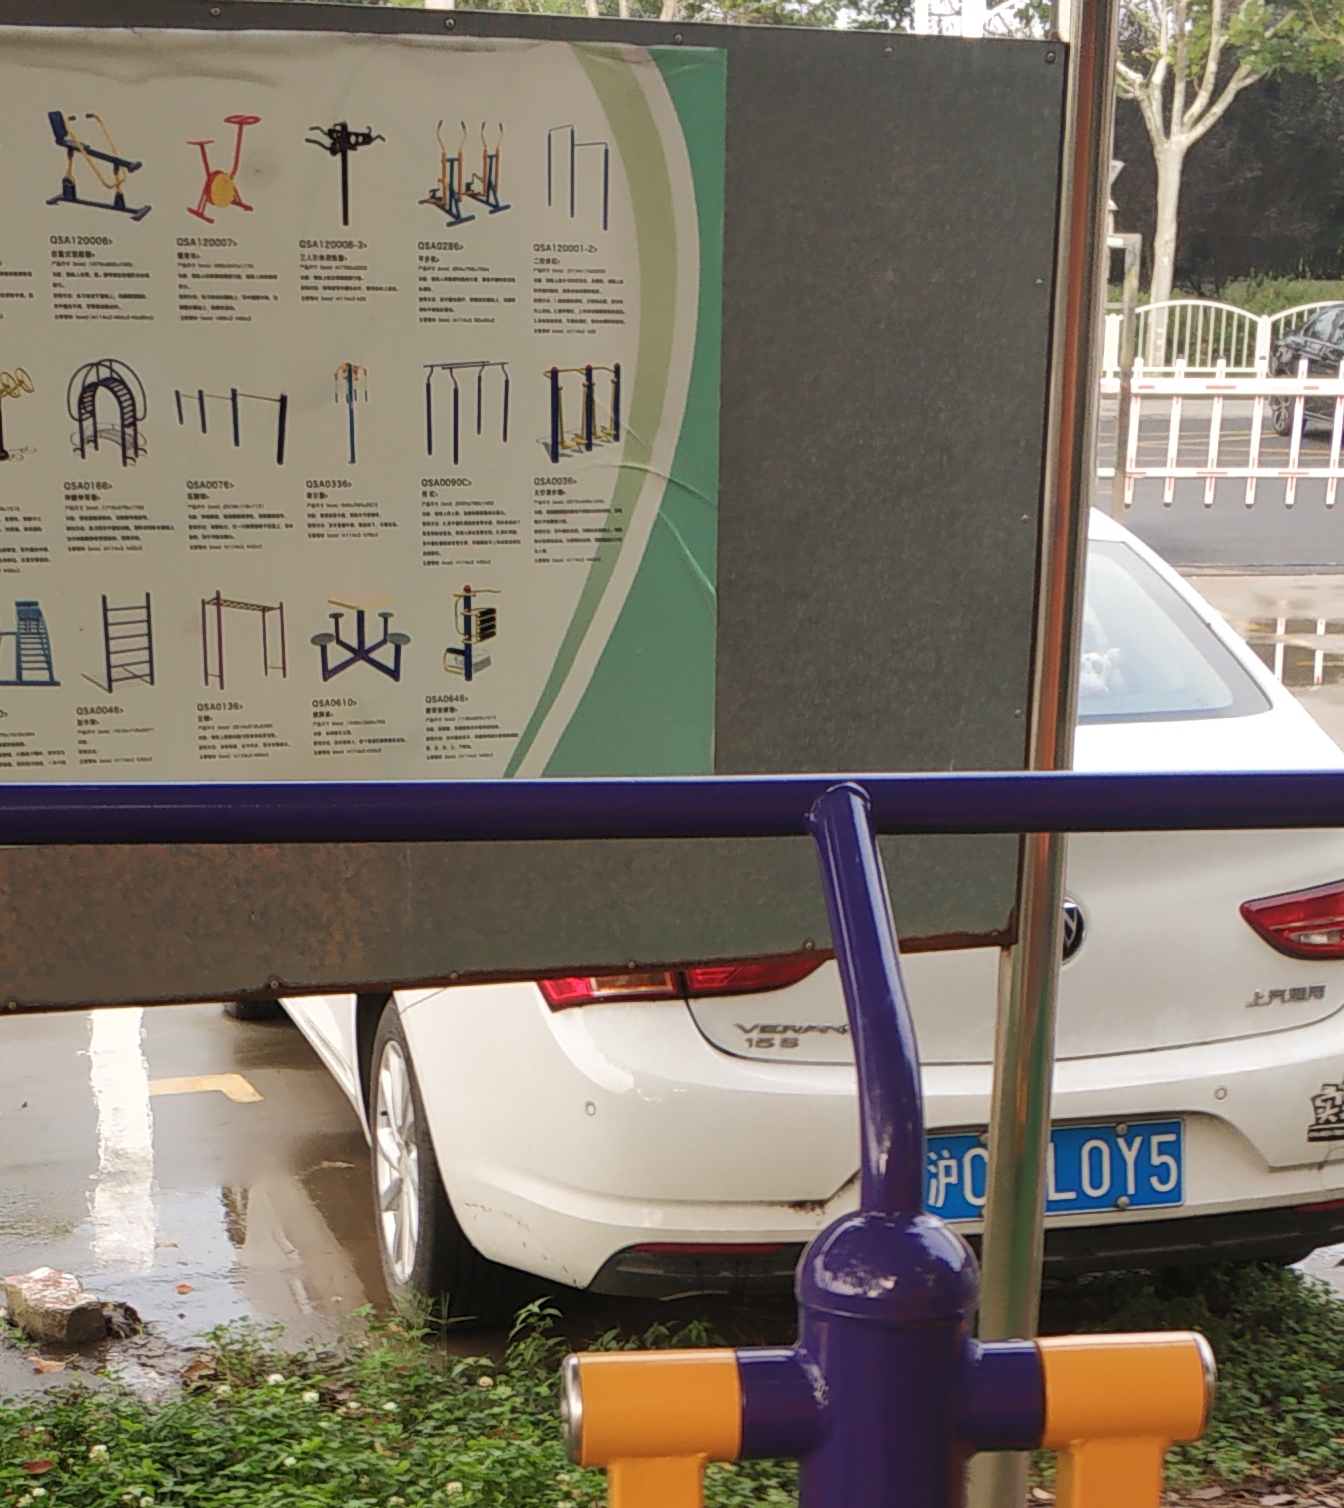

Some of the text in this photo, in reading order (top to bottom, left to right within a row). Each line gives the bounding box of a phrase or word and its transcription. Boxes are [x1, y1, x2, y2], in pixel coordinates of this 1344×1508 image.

[1245, 985, 1325, 1008] 上汽通用
[927, 1133, 1178, 1207] 沪CL0Y5
